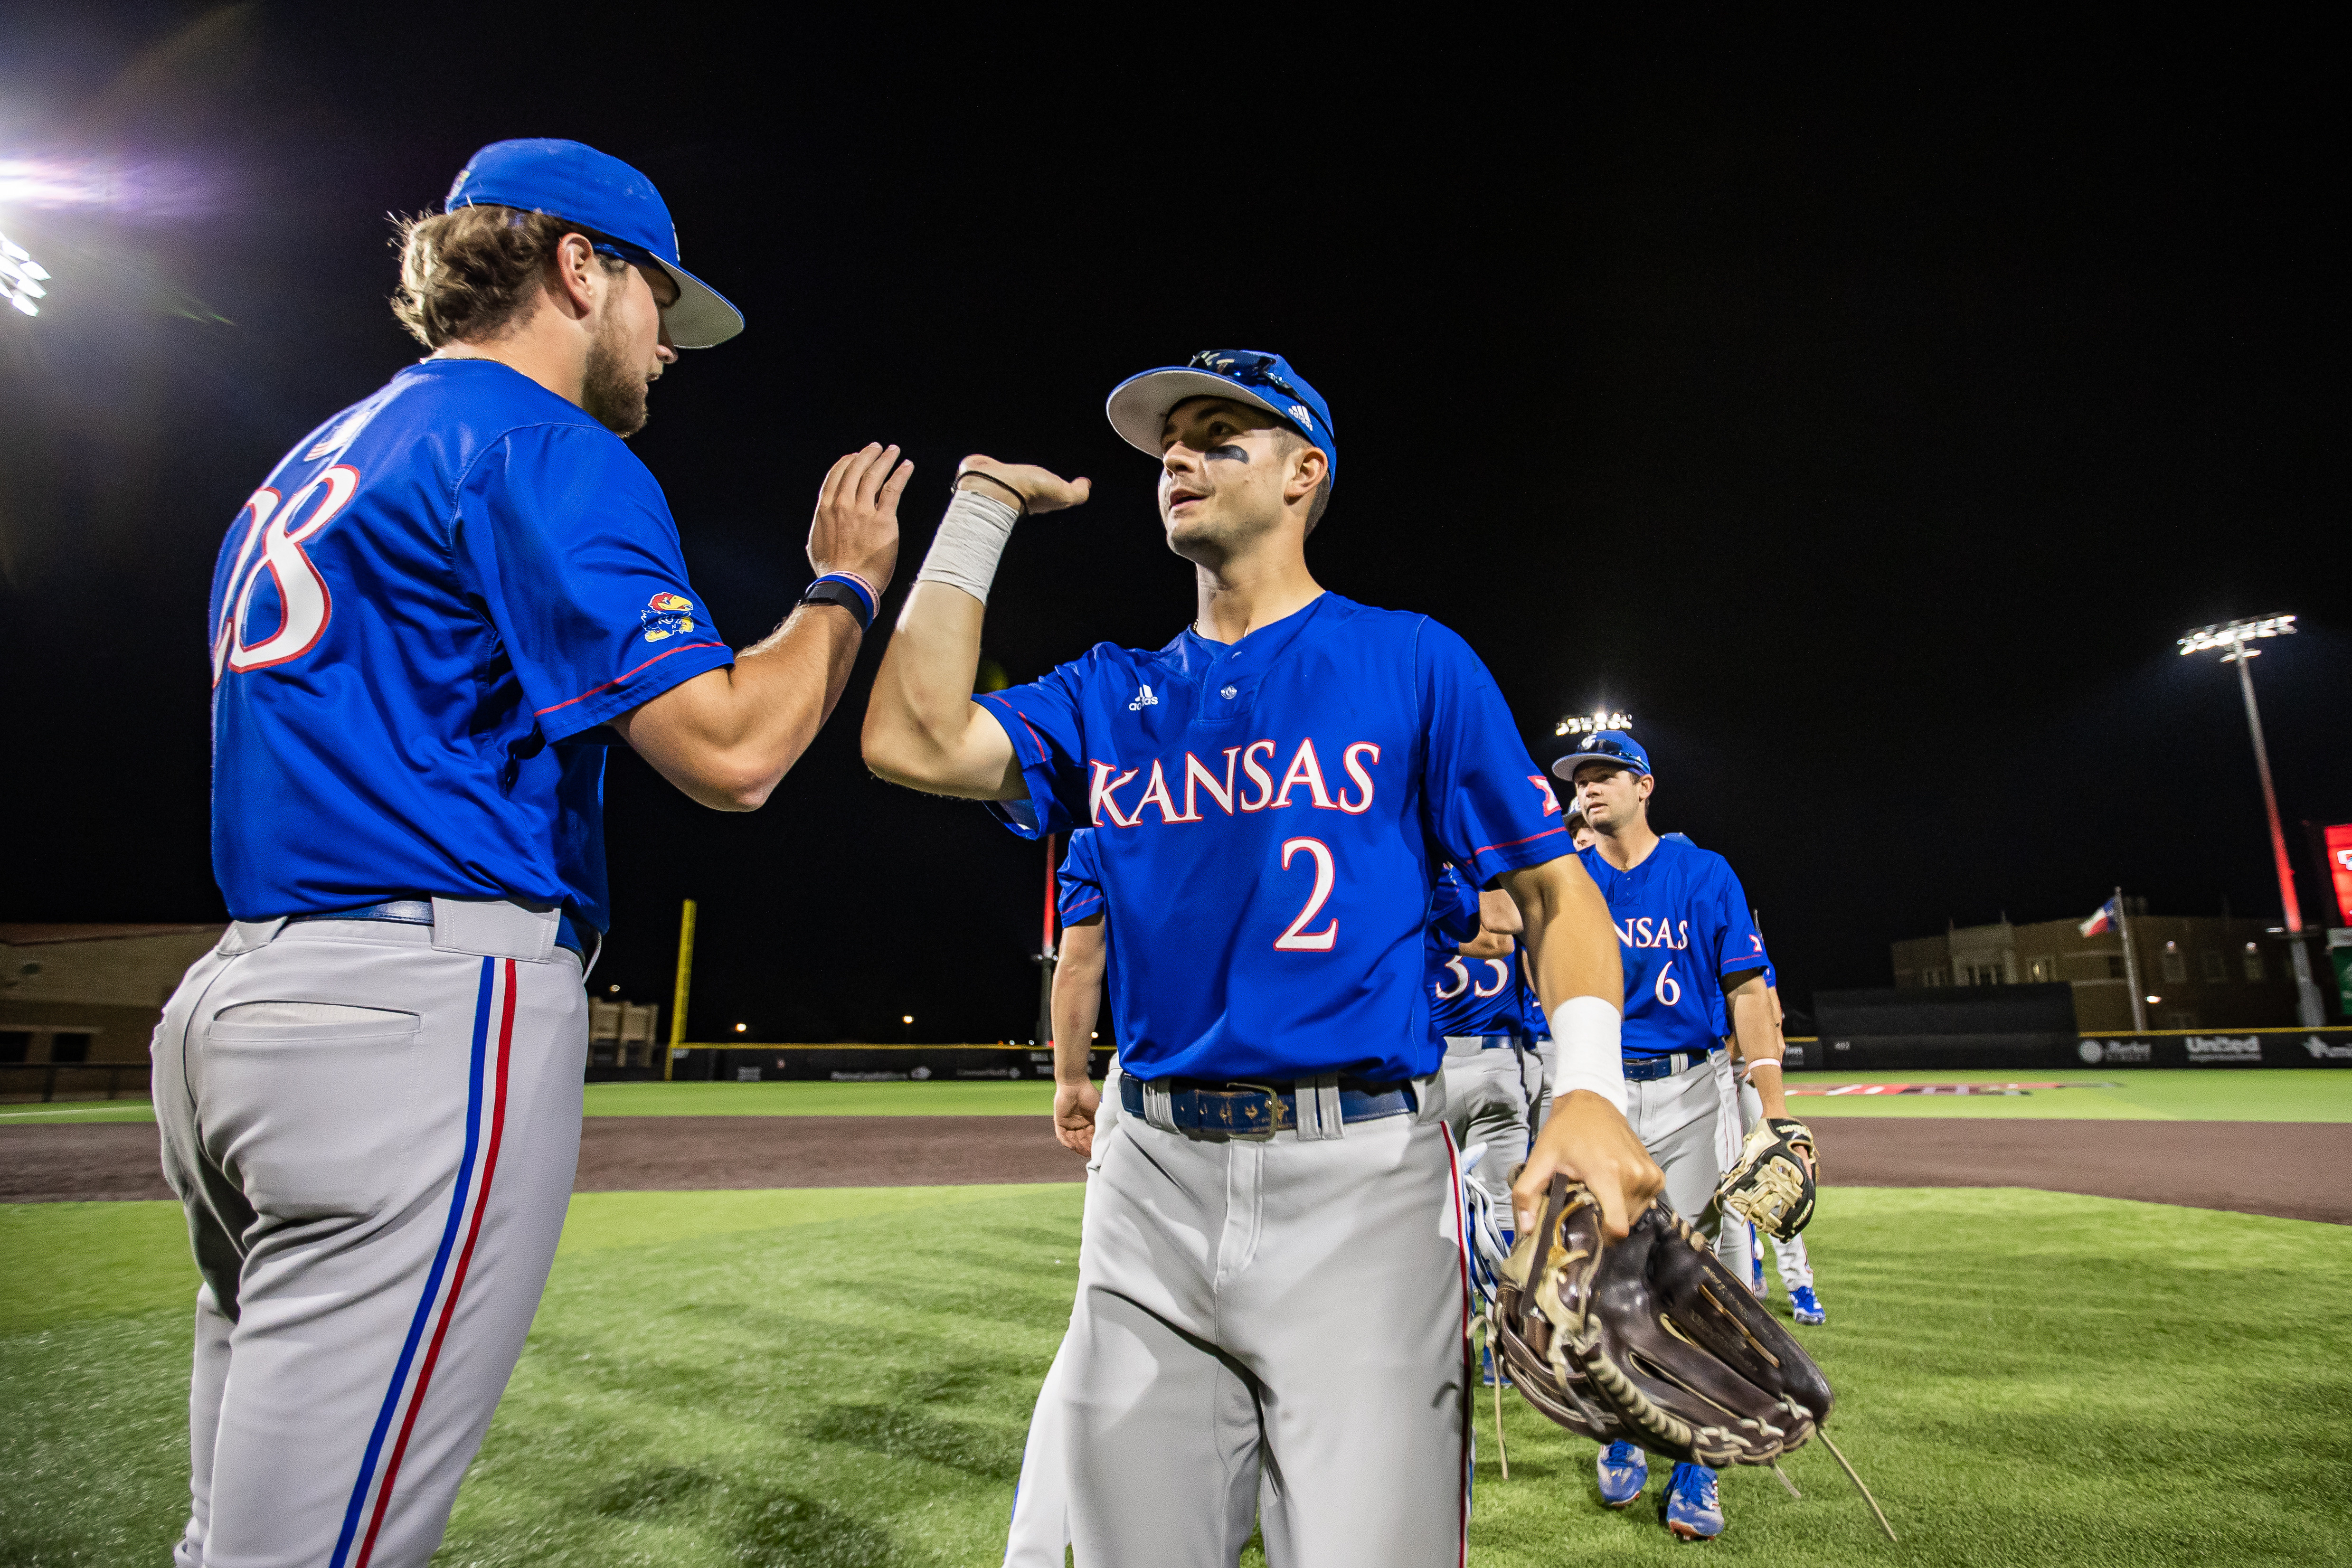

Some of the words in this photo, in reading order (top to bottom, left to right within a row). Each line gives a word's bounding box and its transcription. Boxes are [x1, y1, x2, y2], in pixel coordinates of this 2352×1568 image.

[1288, 407, 1313, 432] adidas
[1128, 696, 1159, 711] adas
[1089, 737, 1381, 829] KANSAS
[1273, 836, 1339, 952] 2
[1613, 916, 1688, 950] NSAS
[1654, 961, 1681, 1007] 6
